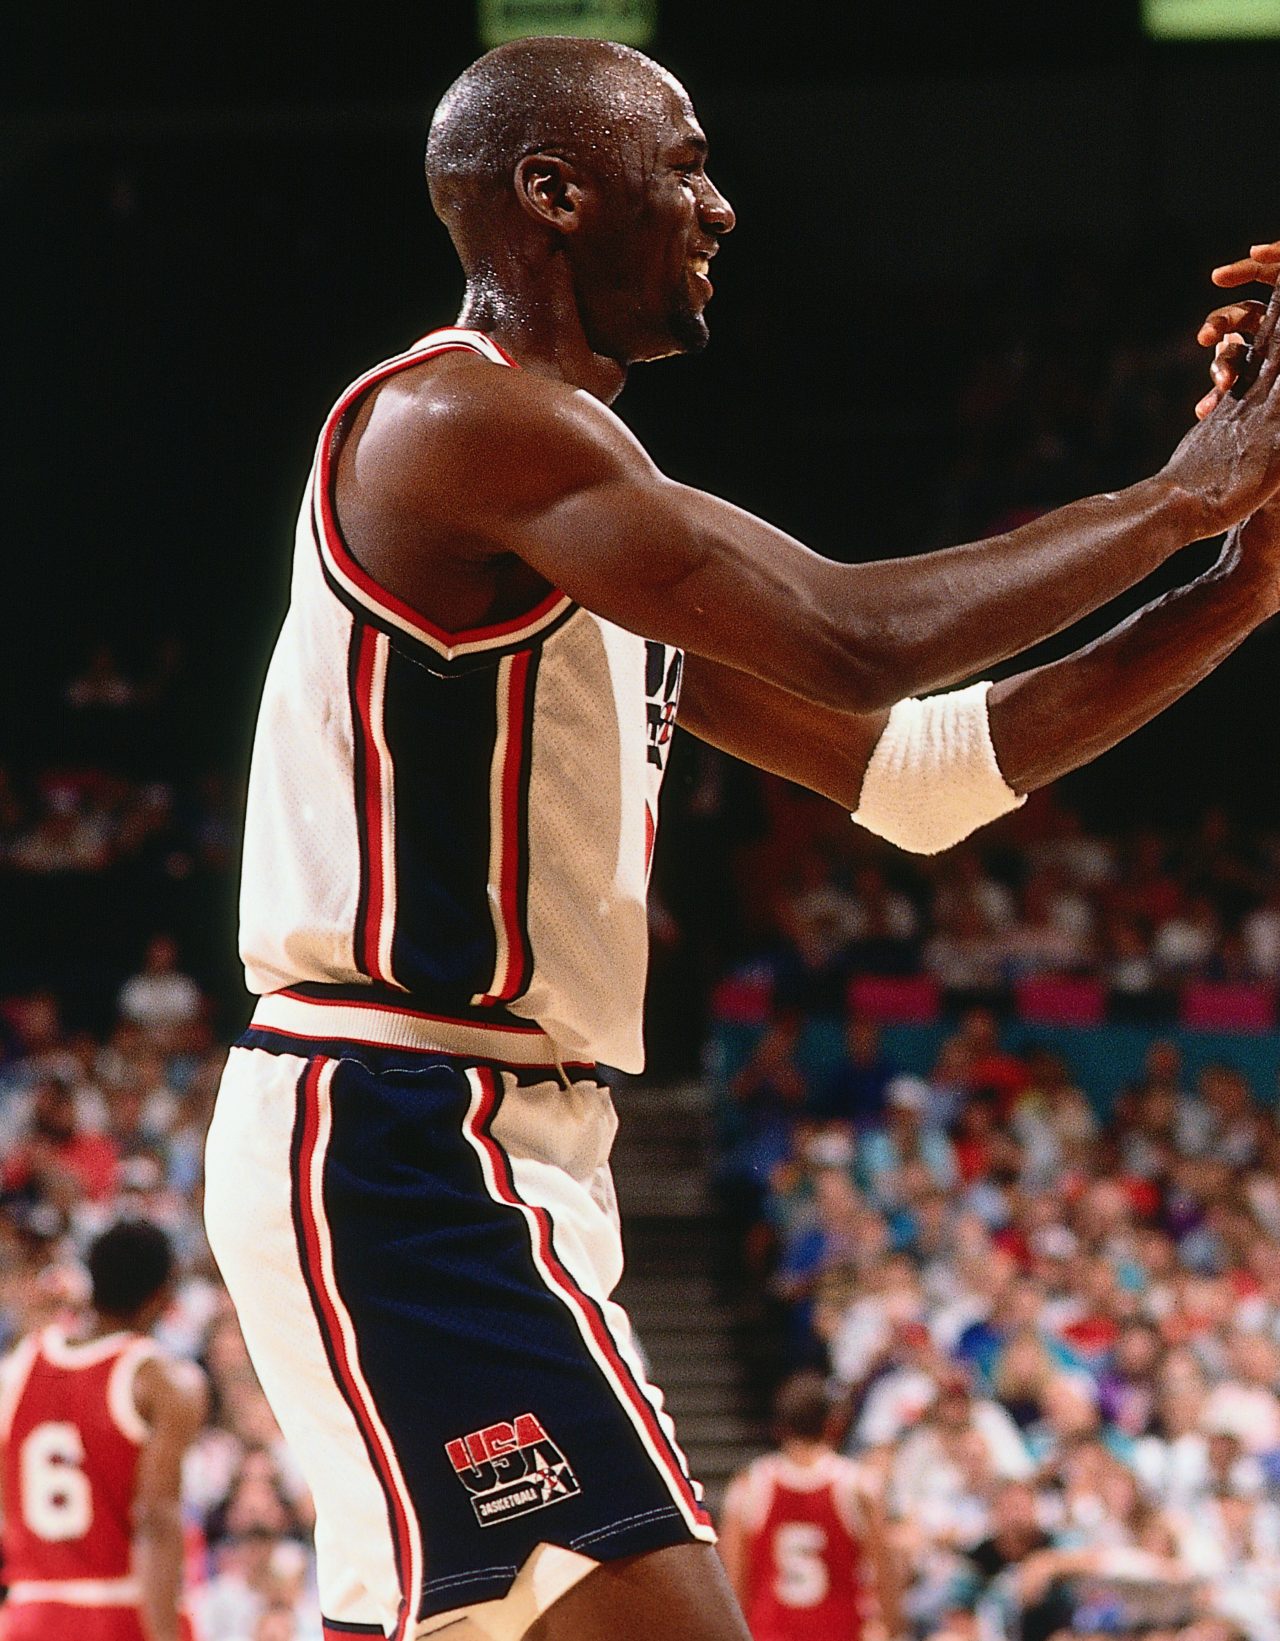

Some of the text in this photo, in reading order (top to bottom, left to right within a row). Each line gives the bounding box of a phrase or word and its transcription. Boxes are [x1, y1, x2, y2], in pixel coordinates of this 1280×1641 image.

[20, 1421, 94, 1542] 6
[445, 1412, 580, 1495] USA
[479, 1488, 538, 1516] BASKETBALL
[773, 1522, 830, 1609] 5
